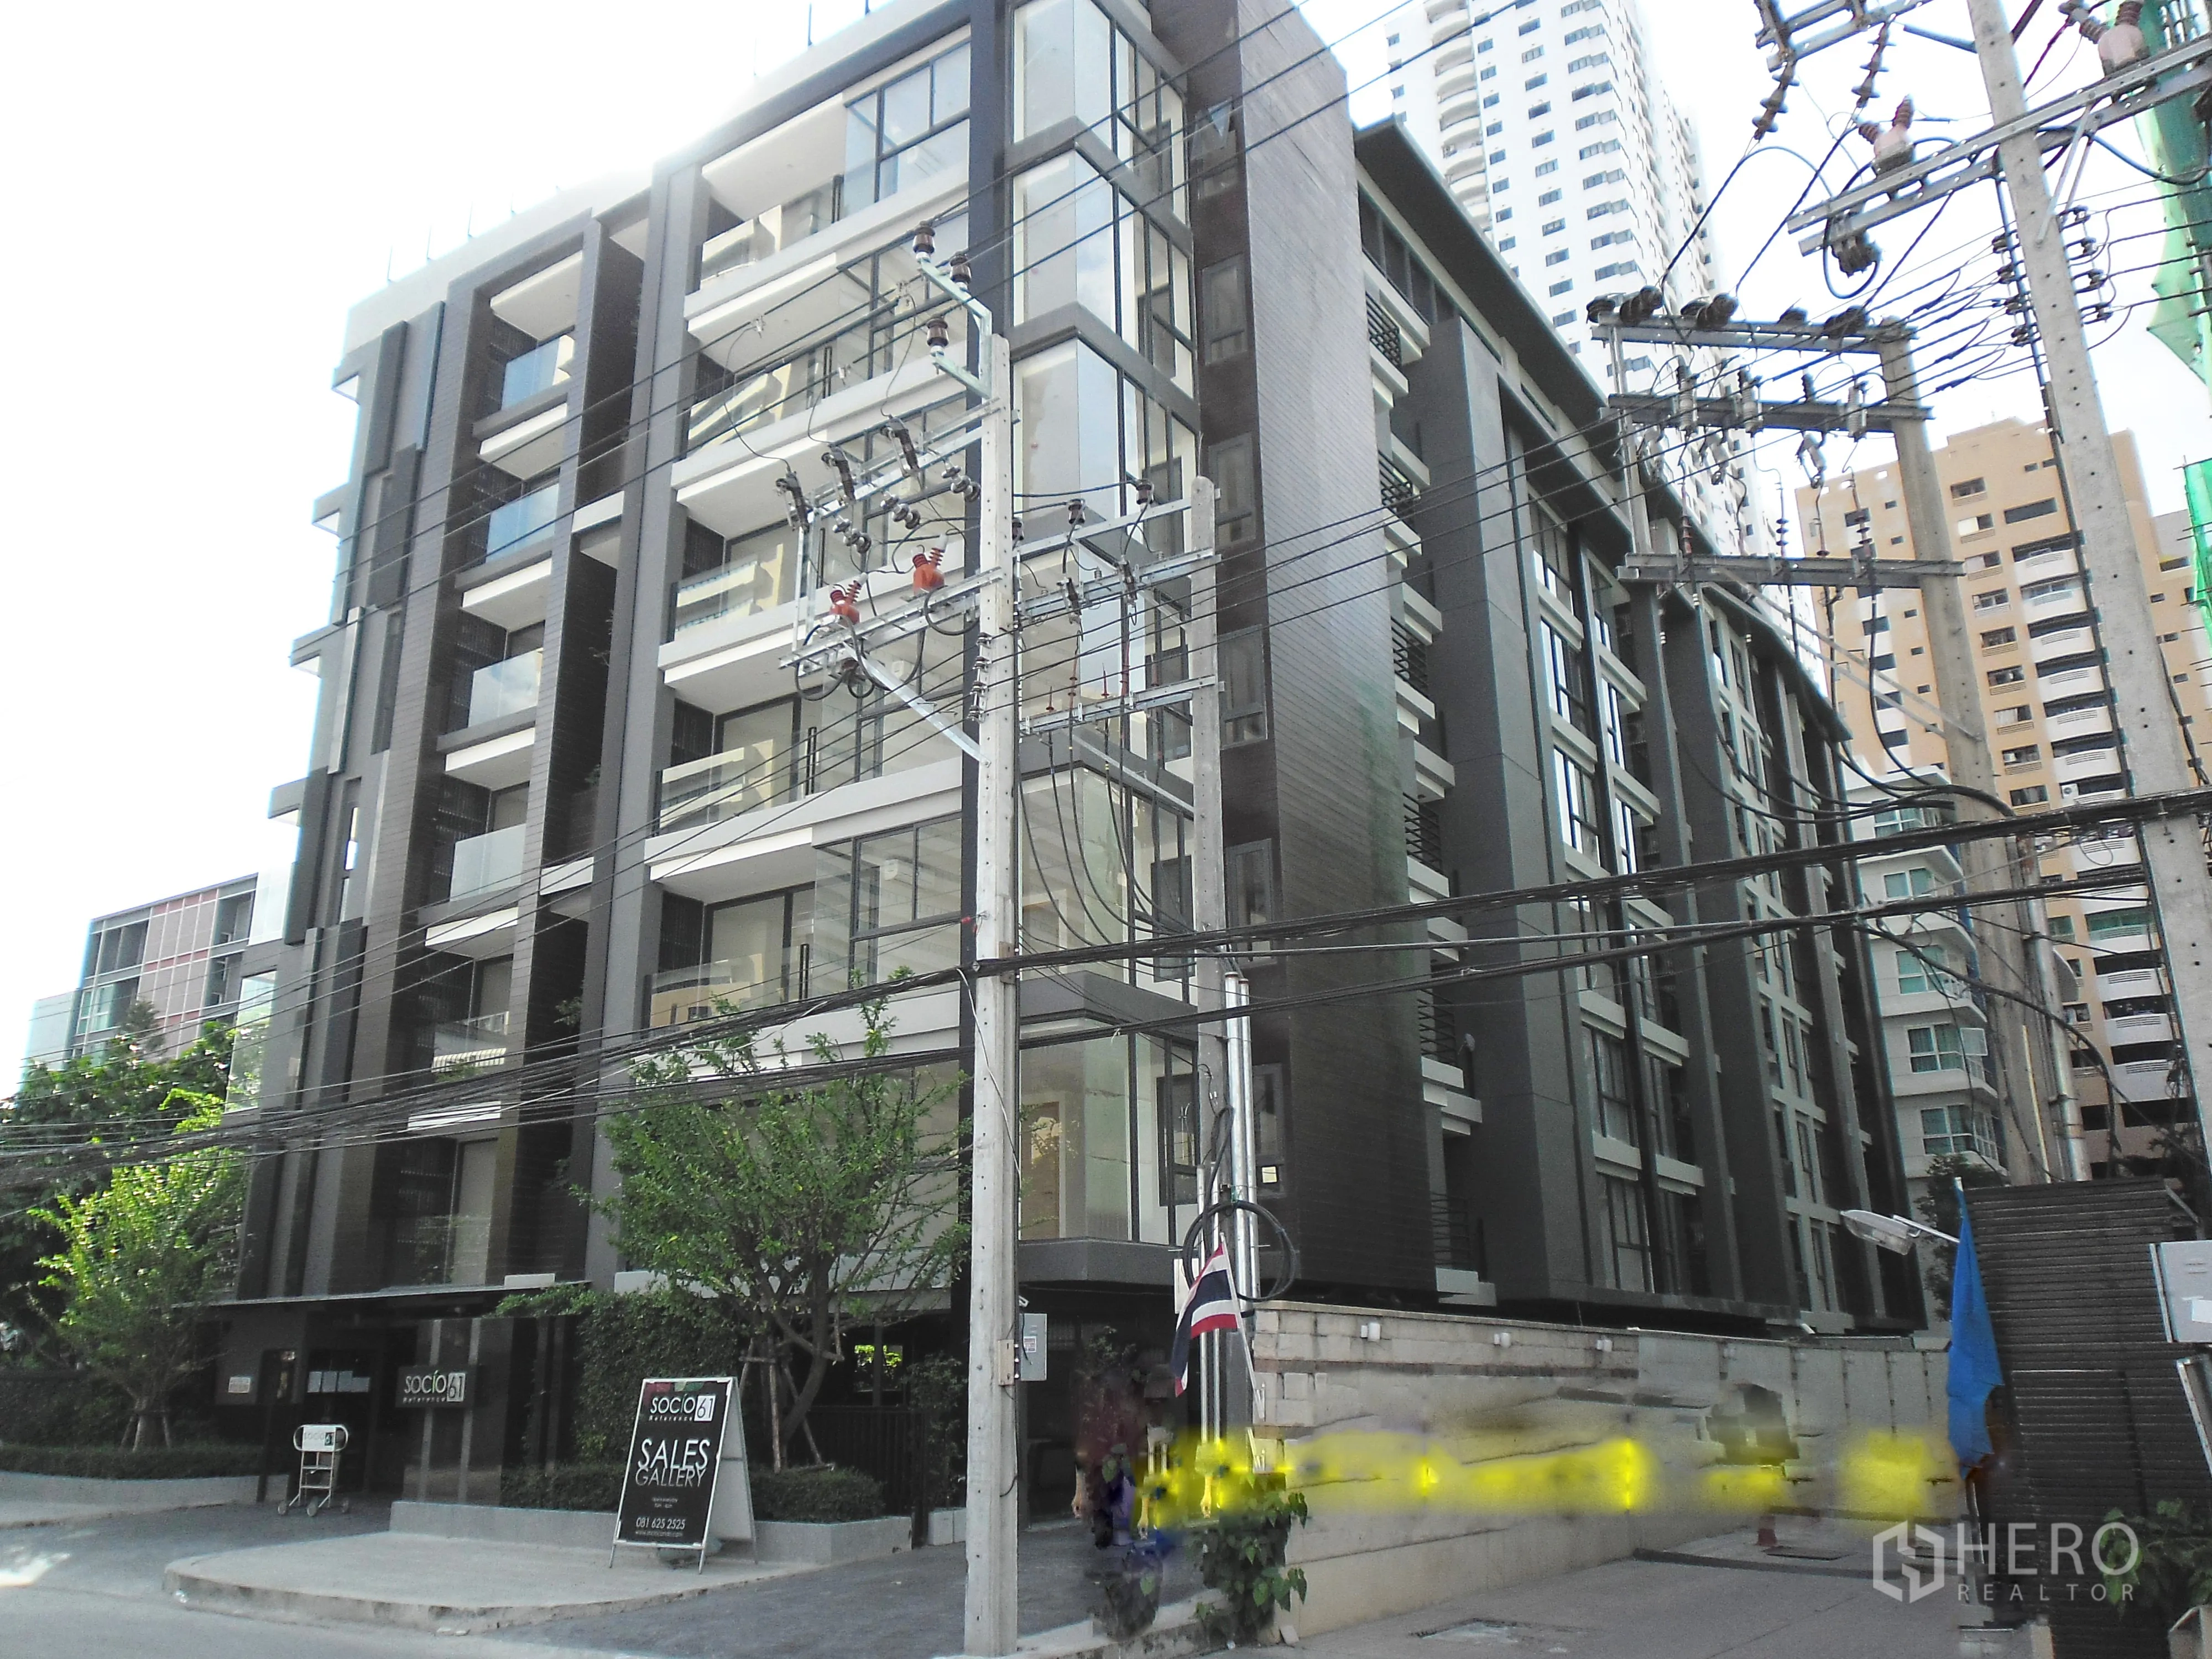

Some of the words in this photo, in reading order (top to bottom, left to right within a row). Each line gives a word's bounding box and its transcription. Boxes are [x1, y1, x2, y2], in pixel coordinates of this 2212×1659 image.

[697, 1397, 713, 1418] 61
[638, 1438, 710, 1470] SALES
[635, 1467, 706, 1487] GALLERY
[636, 1517, 649, 1528] 081
[651, 1518, 665, 1529] 625
[666, 1519, 686, 1530] 2525
